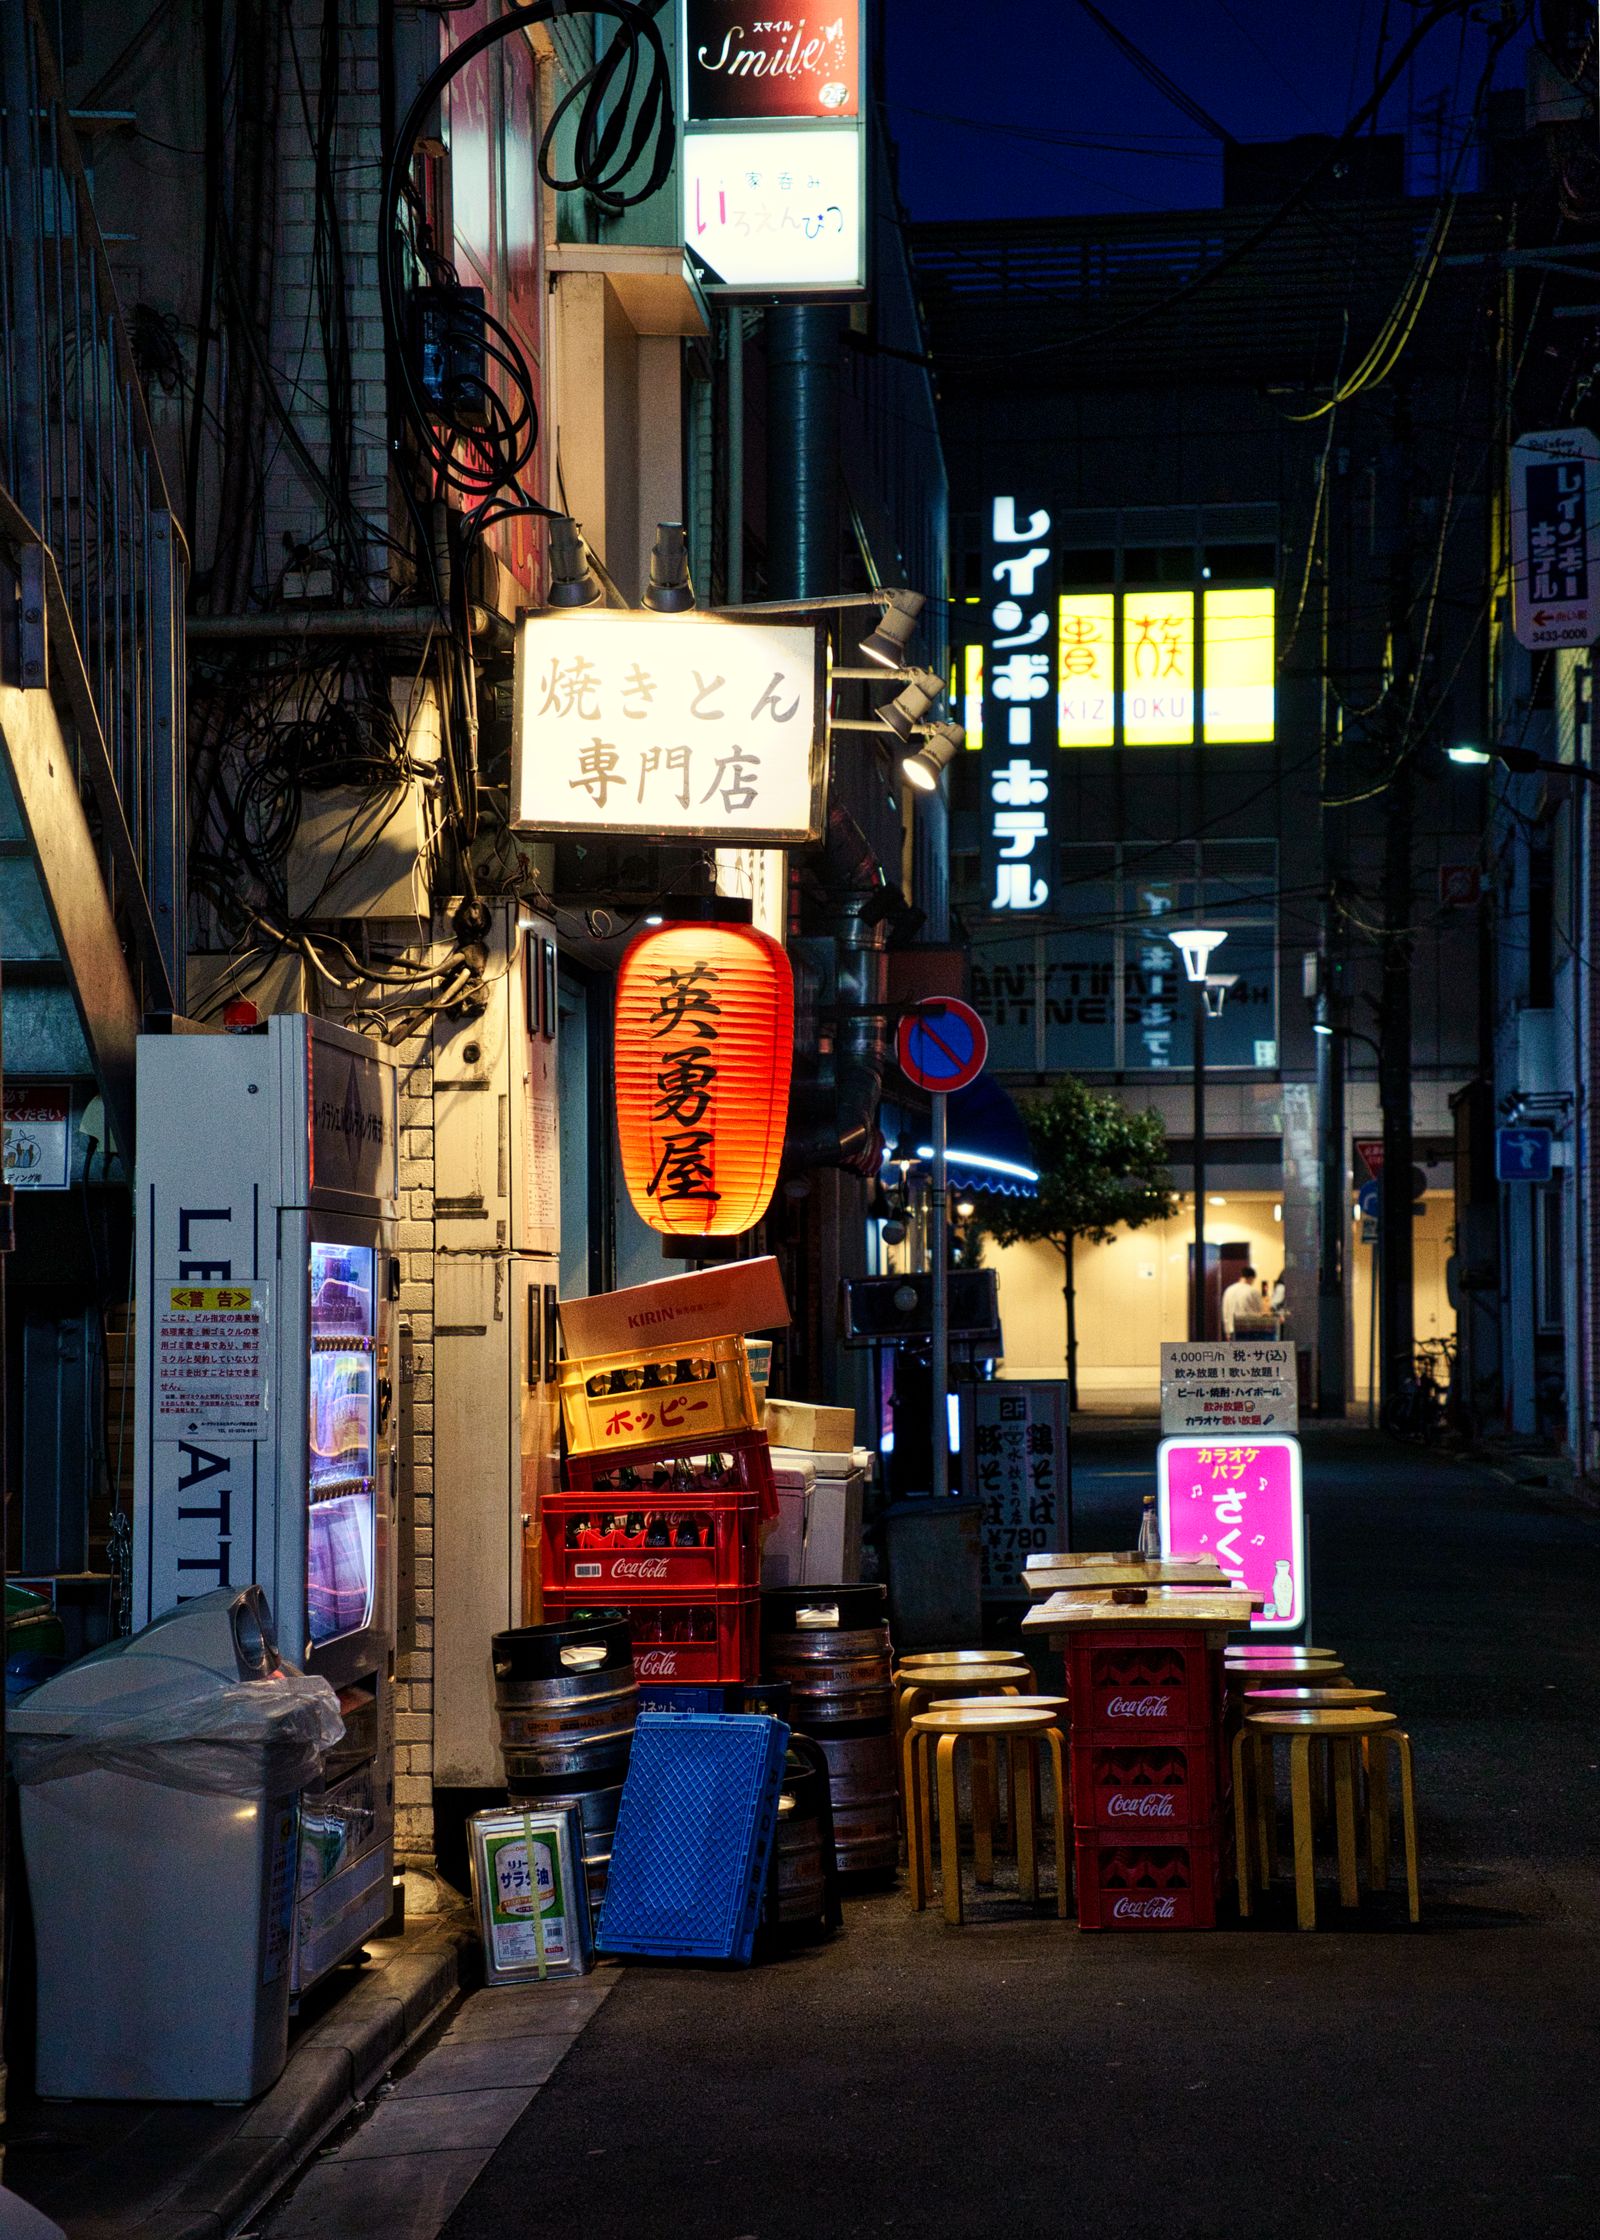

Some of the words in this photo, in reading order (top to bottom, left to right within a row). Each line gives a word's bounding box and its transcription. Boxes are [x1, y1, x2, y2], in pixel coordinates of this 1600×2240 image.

[752, 20, 794, 33] スマイル
[698, 18, 826, 78] Smile
[1557, 466, 1583, 597] レインボー
[1531, 521, 1558, 599] ホテル
[537, 655, 801, 723] 焼きとん
[992, 496, 1051, 910] レインボーホテル
[568, 737, 761, 814] 専門店
[647, 960, 722, 1202] 英勇屋
[627, 1306, 675, 1330] KIRIN
[1170, 1352, 1226, 1363] 4,000円/h
[605, 1396, 709, 1437] ホッピー
[1002, 1401, 1025, 1416] 2F
[1203, 1401, 1245, 1412] 飲み放題
[1197, 1448, 1260, 1464] カラオケ
[1211, 1464, 1247, 1480] パブ
